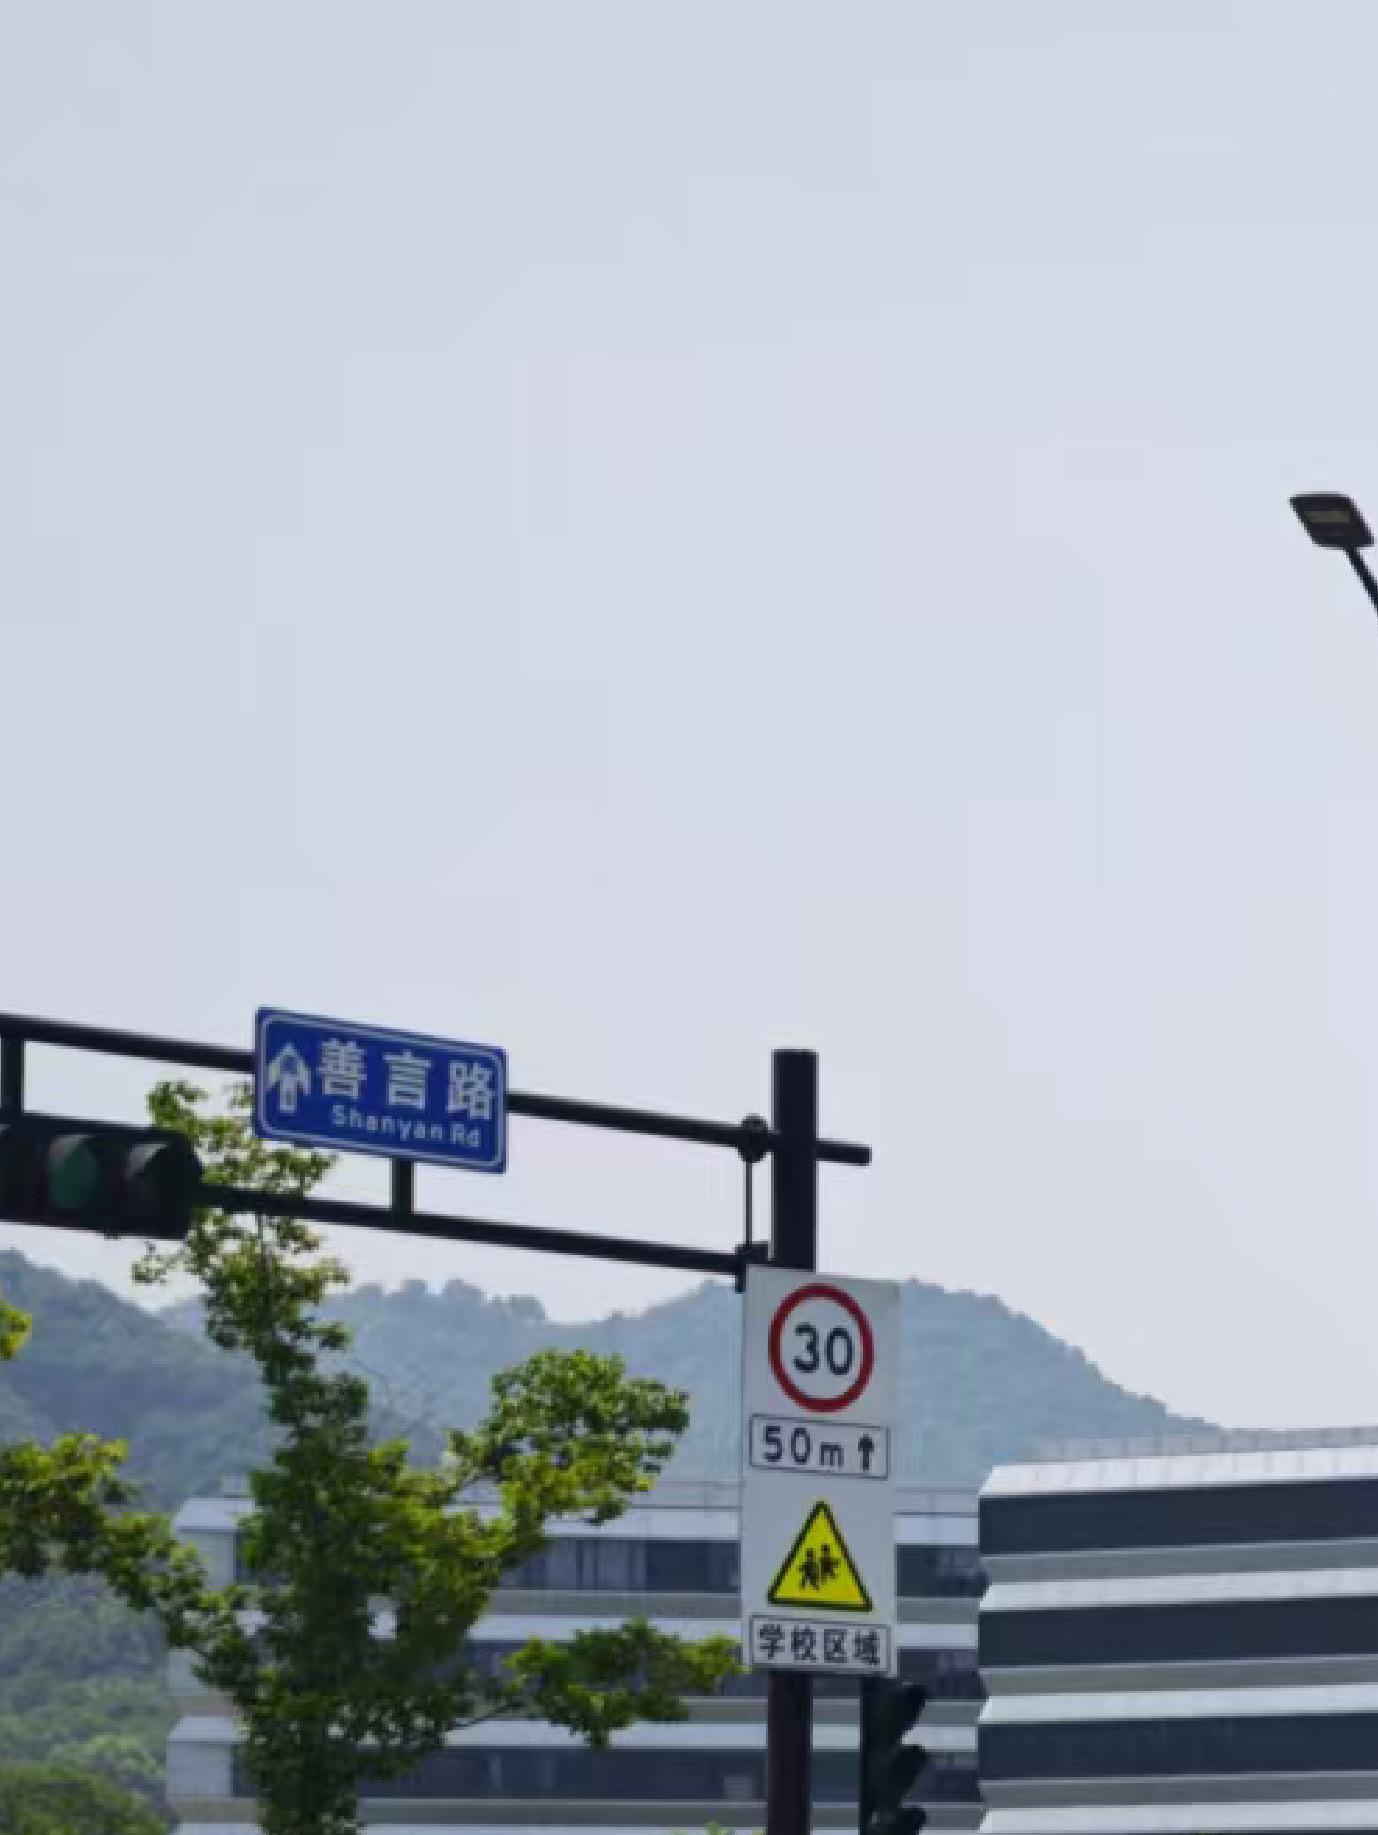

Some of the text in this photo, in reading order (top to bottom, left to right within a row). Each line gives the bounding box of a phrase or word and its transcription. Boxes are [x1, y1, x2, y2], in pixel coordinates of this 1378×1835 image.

[318, 1038, 496, 1121] 善言路
[331, 1104, 482, 1148] Shanyan Rd
[794, 1322, 855, 1376] 30
[764, 1424, 845, 1467] 50m
[757, 1624, 881, 1666] 学校区域
